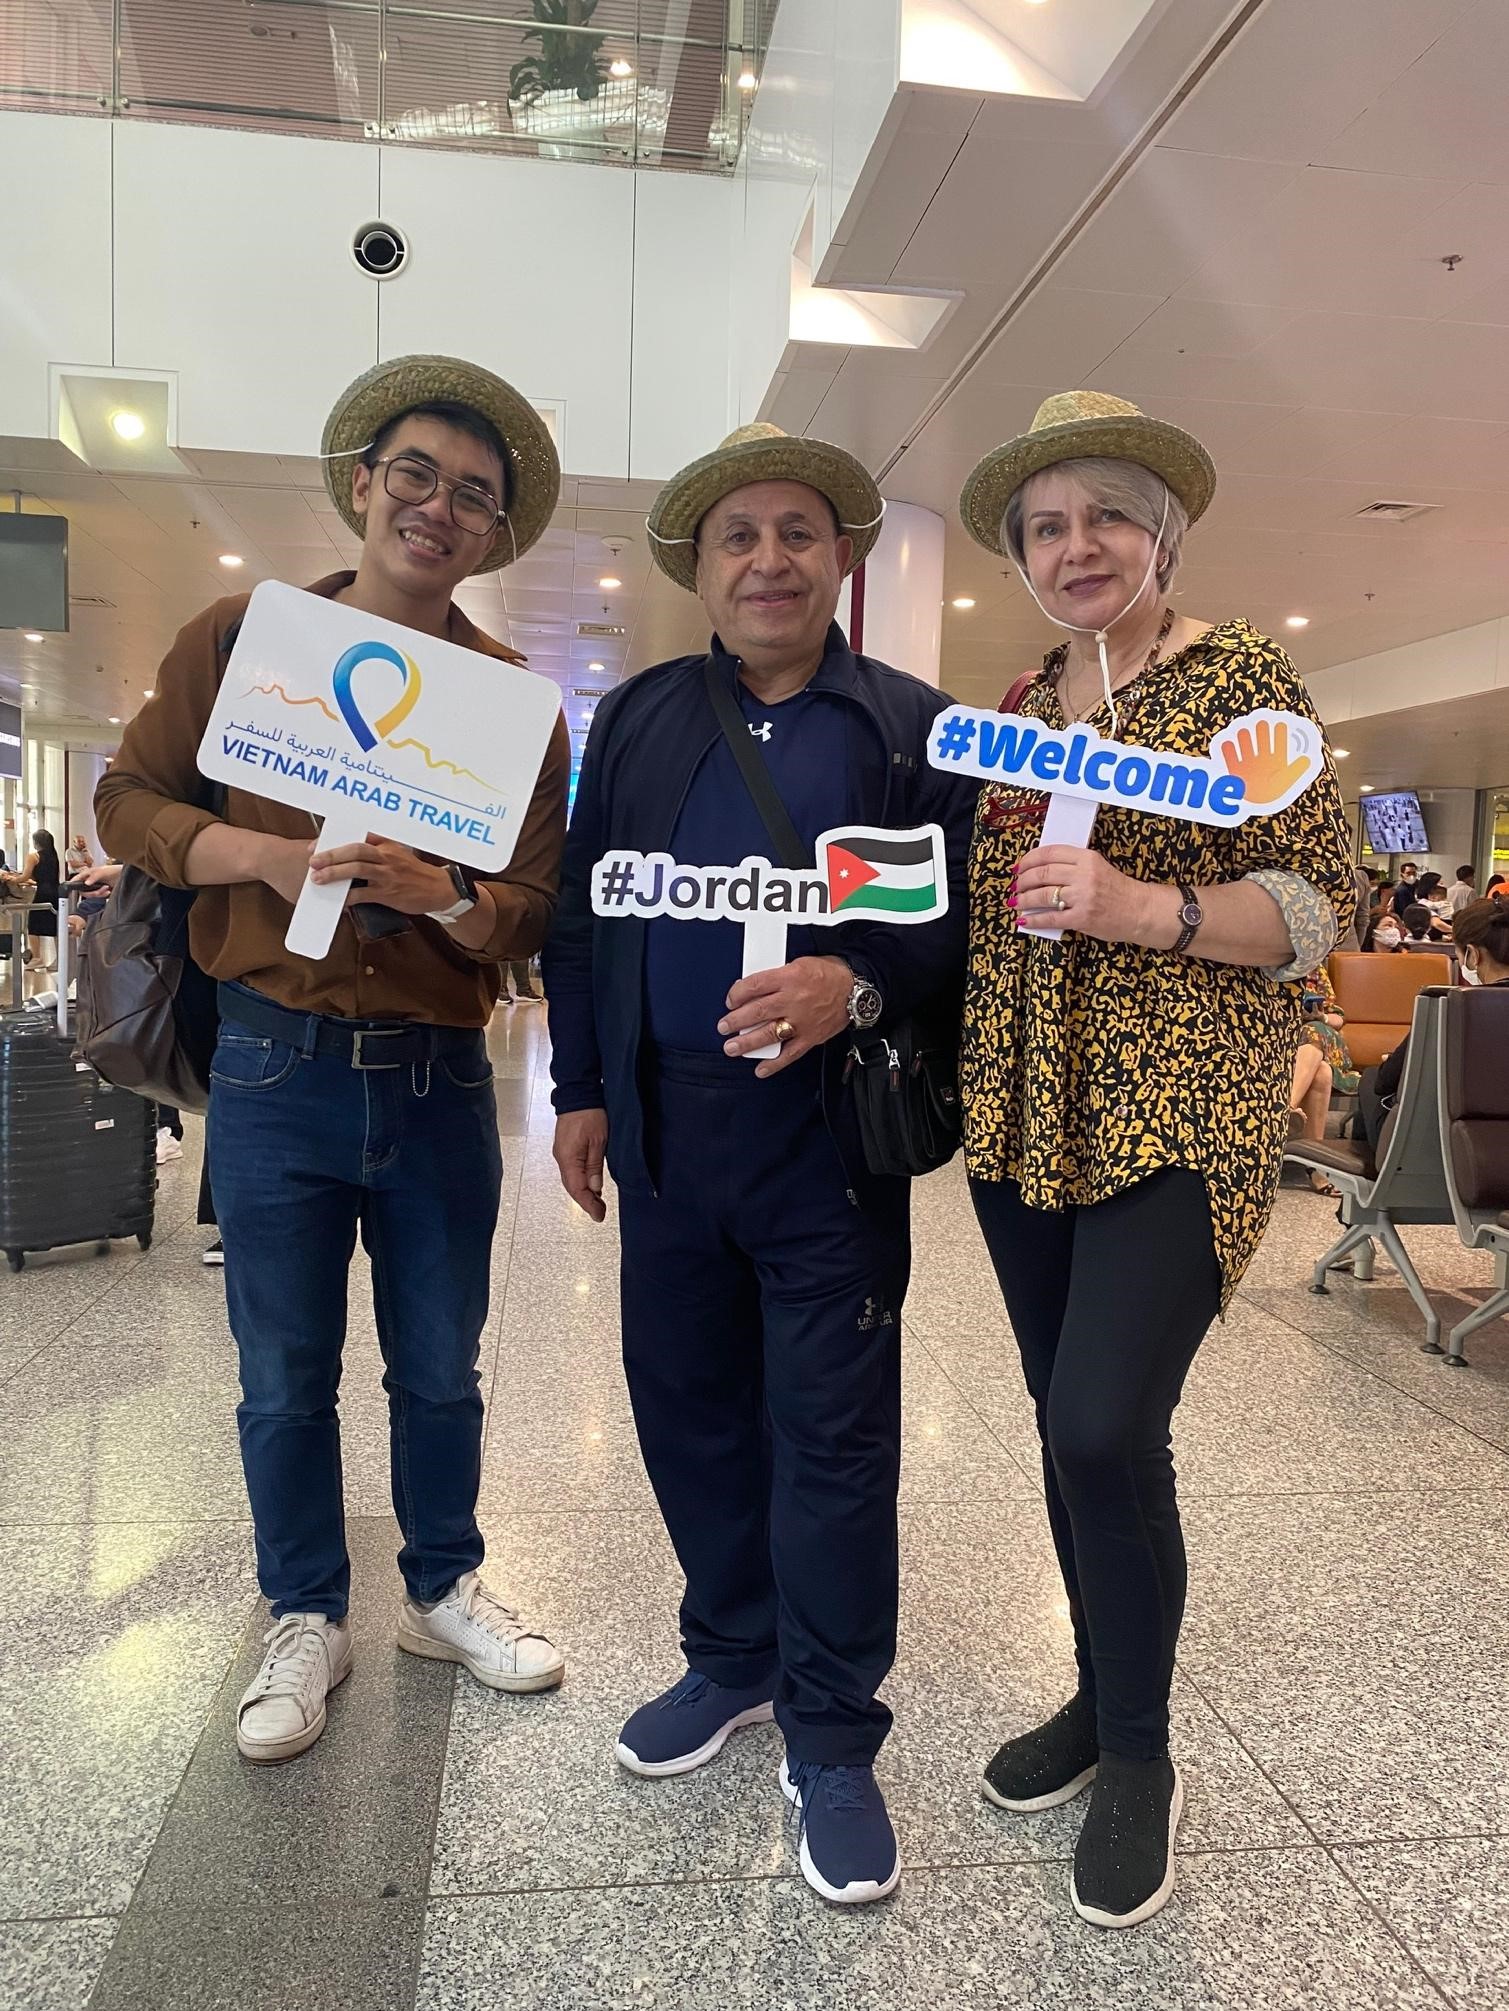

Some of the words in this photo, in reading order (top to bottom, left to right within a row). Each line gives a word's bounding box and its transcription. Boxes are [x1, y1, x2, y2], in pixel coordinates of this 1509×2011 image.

[225, 719, 283, 742] للسفر
[287, 734, 337, 761] العربية
[222, 734, 329, 788] VIETNAM
[331, 775, 402, 812] ARAB
[409, 797, 496, 845] TRAVEL
[936, 714, 1247, 817] #Welcome
[601, 860, 829, 914] #Jordan
